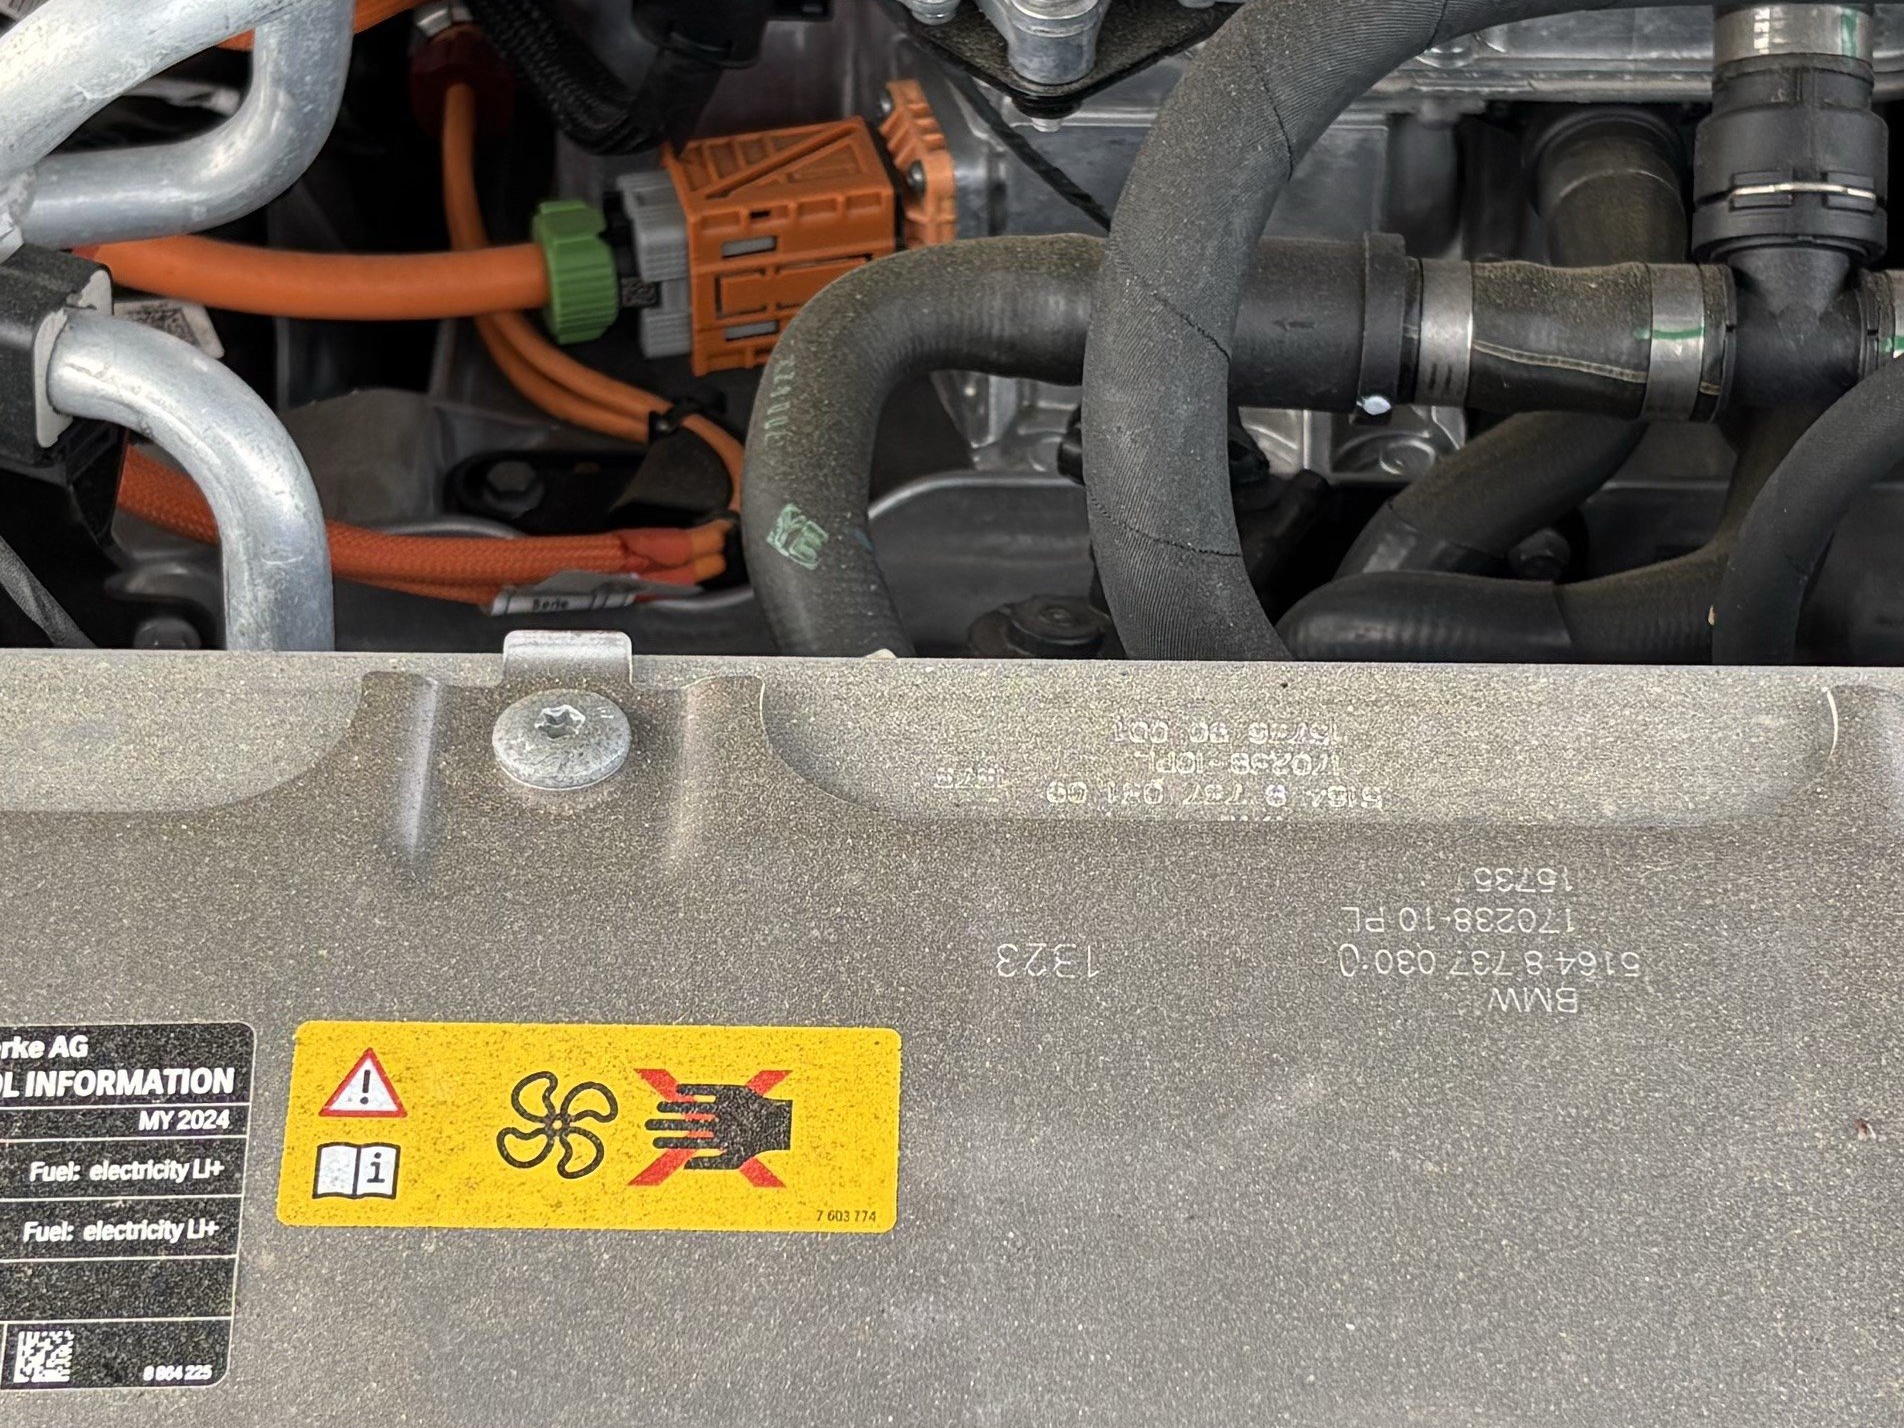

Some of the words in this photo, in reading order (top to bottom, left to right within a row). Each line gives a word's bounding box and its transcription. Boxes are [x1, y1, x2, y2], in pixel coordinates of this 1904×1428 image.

[1341, 906, 1385, 933] PL
[996, 941, 1100, 981] 1323
[1374, 949, 1436, 975] 030
[1448, 950, 1508, 976] 737
[1523, 950, 1544, 976] 8
[1487, 987, 1578, 1014] BMW
[48, 1034, 89, 1059] AG
[24, 1067, 236, 1097] INFORMATION
[138, 1111, 175, 1131] MY
[176, 1109, 231, 1130] 2024
[29, 1161, 81, 1183] Fuel:
[89, 1159, 190, 1184] electricity
[816, 1210, 824, 1222] 7
[827, 1209, 850, 1223] 603
[854, 1209, 877, 1223] 774
[23, 1220, 75, 1243] Fuel:
[83, 1218, 185, 1244] electricity
[184, 1364, 213, 1380] 225
